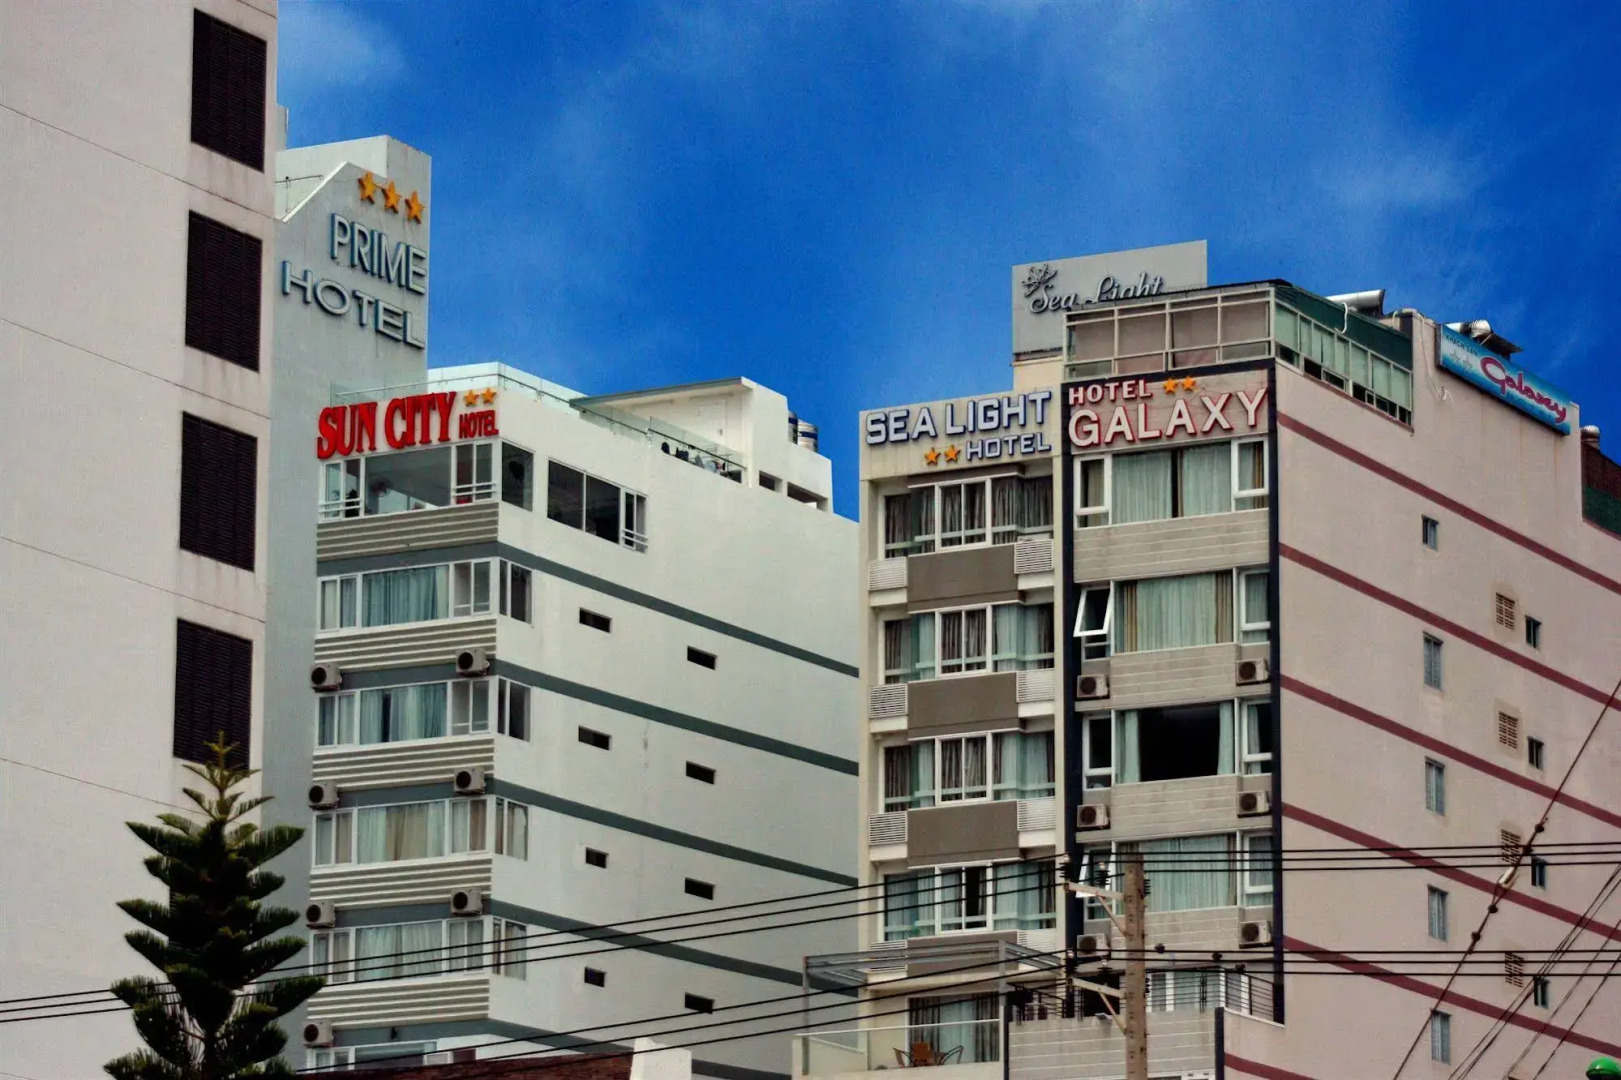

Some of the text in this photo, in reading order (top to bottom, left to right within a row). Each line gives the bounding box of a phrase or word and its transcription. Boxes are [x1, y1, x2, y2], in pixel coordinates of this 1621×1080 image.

[330, 212, 427, 296] PRIME
[282, 260, 425, 350] HOTEL
[1029, 283, 1078, 313] Sea
[865, 390, 1052, 446] SEA LIGHT
[1068, 378, 1152, 406] HOTEL
[1068, 387, 1269, 448] GALAXY
[1479, 356, 1567, 425] Galaxy
[317, 390, 457, 459] SUN CITY
[458, 409, 499, 439] HOTEL
[965, 431, 1052, 462] HOTEL
